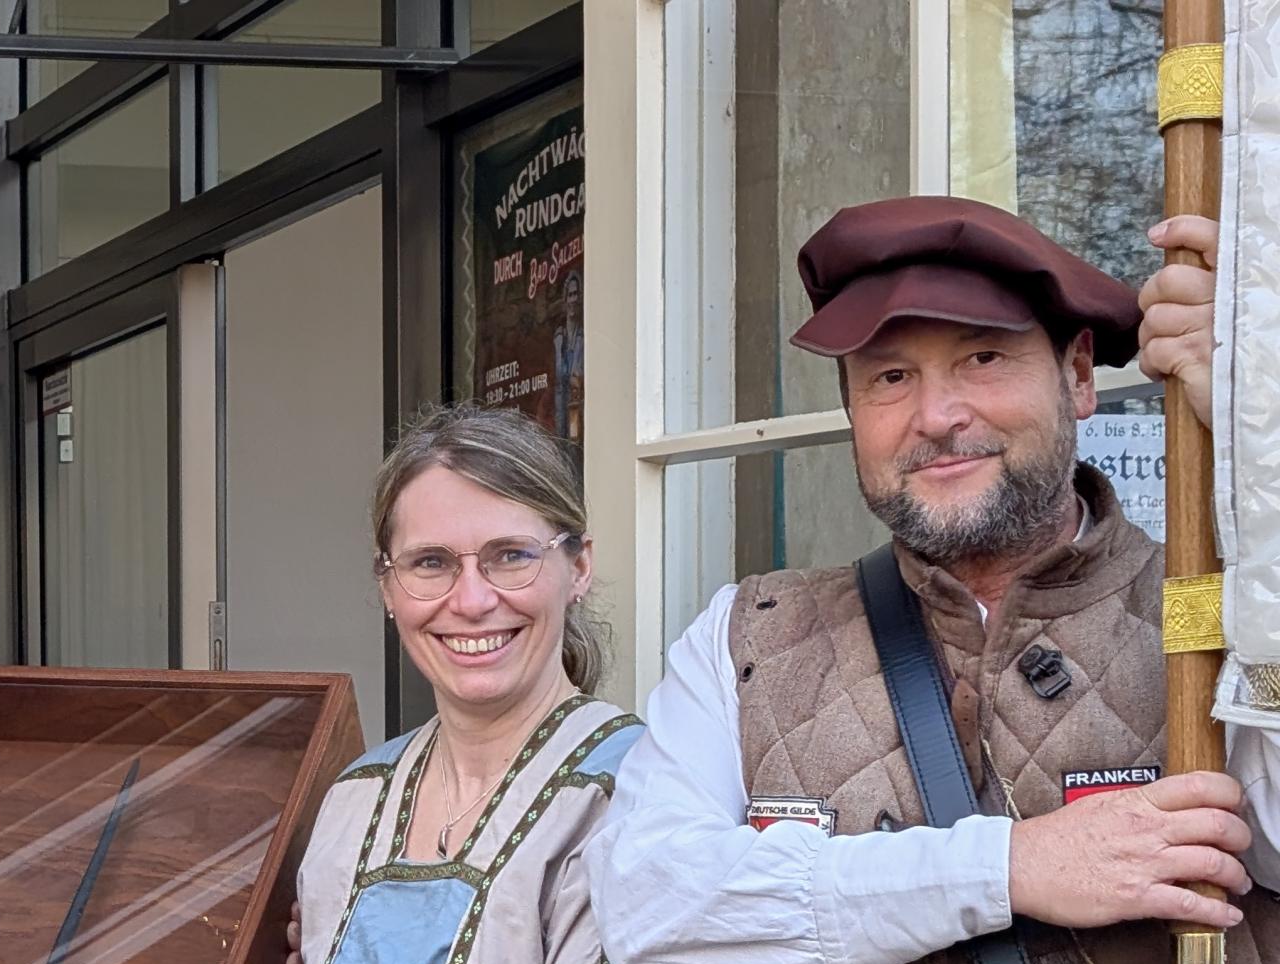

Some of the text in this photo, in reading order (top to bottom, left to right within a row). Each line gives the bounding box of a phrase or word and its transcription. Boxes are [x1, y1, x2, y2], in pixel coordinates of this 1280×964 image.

[494, 251, 523, 285] DURCH
[485, 360, 520, 387] UHRZEIT:
[509, 378, 530, 398] 21:00
[532, 373, 548, 391] UHR
[1085, 422, 1145, 437] 6. bis 8.
[1065, 768, 1156, 787] FRANKEN
[752, 806, 816, 815] DEUTSCHE GILDE
